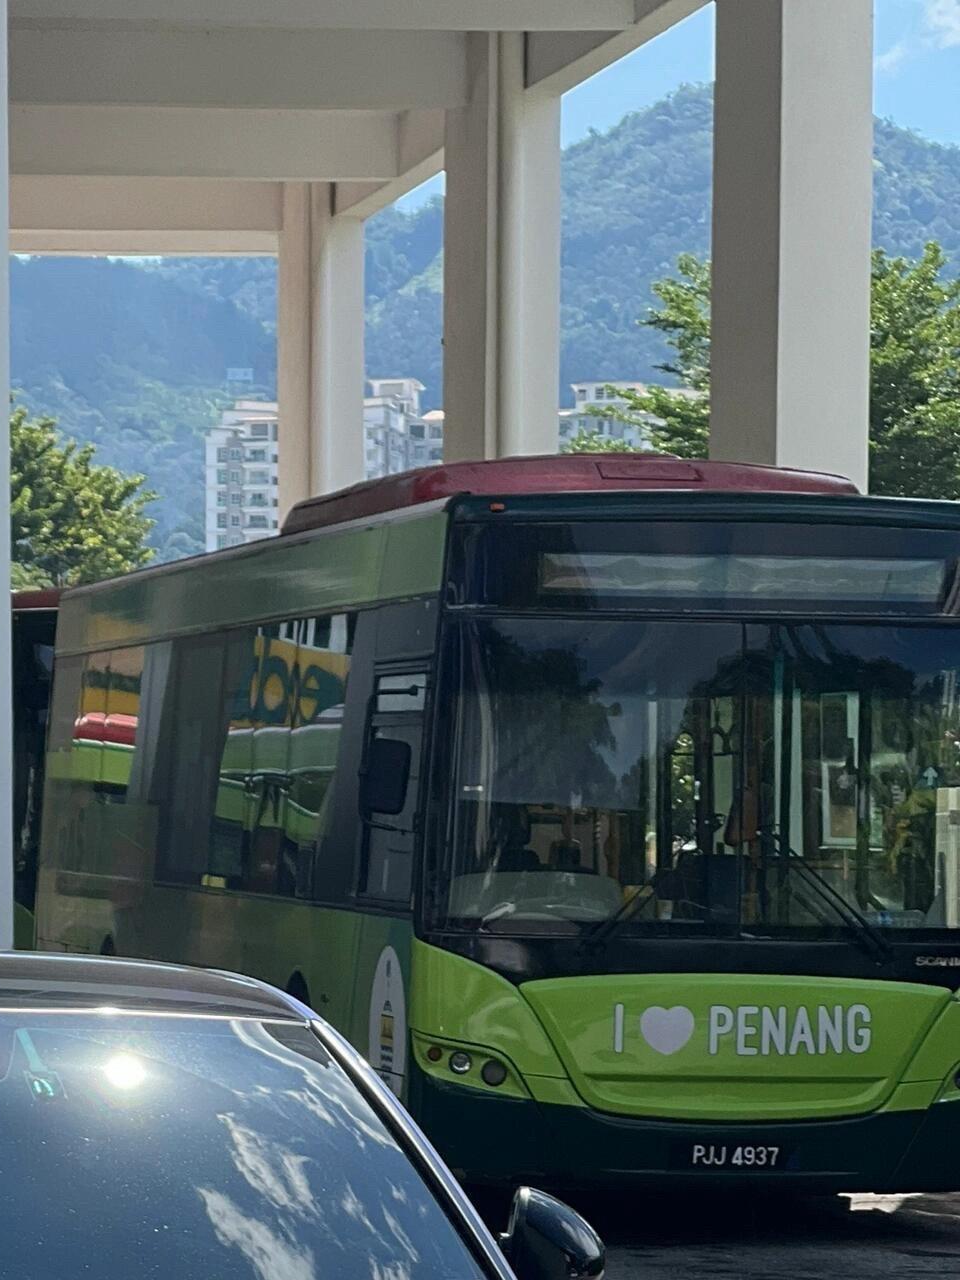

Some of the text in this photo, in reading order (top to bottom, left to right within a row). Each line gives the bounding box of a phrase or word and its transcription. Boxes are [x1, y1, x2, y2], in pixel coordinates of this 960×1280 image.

[915, 956, 960, 967] SCANI
[614, 1003, 872, 1056] I PENANG
[692, 1145, 779, 1166] PJJ 4937
